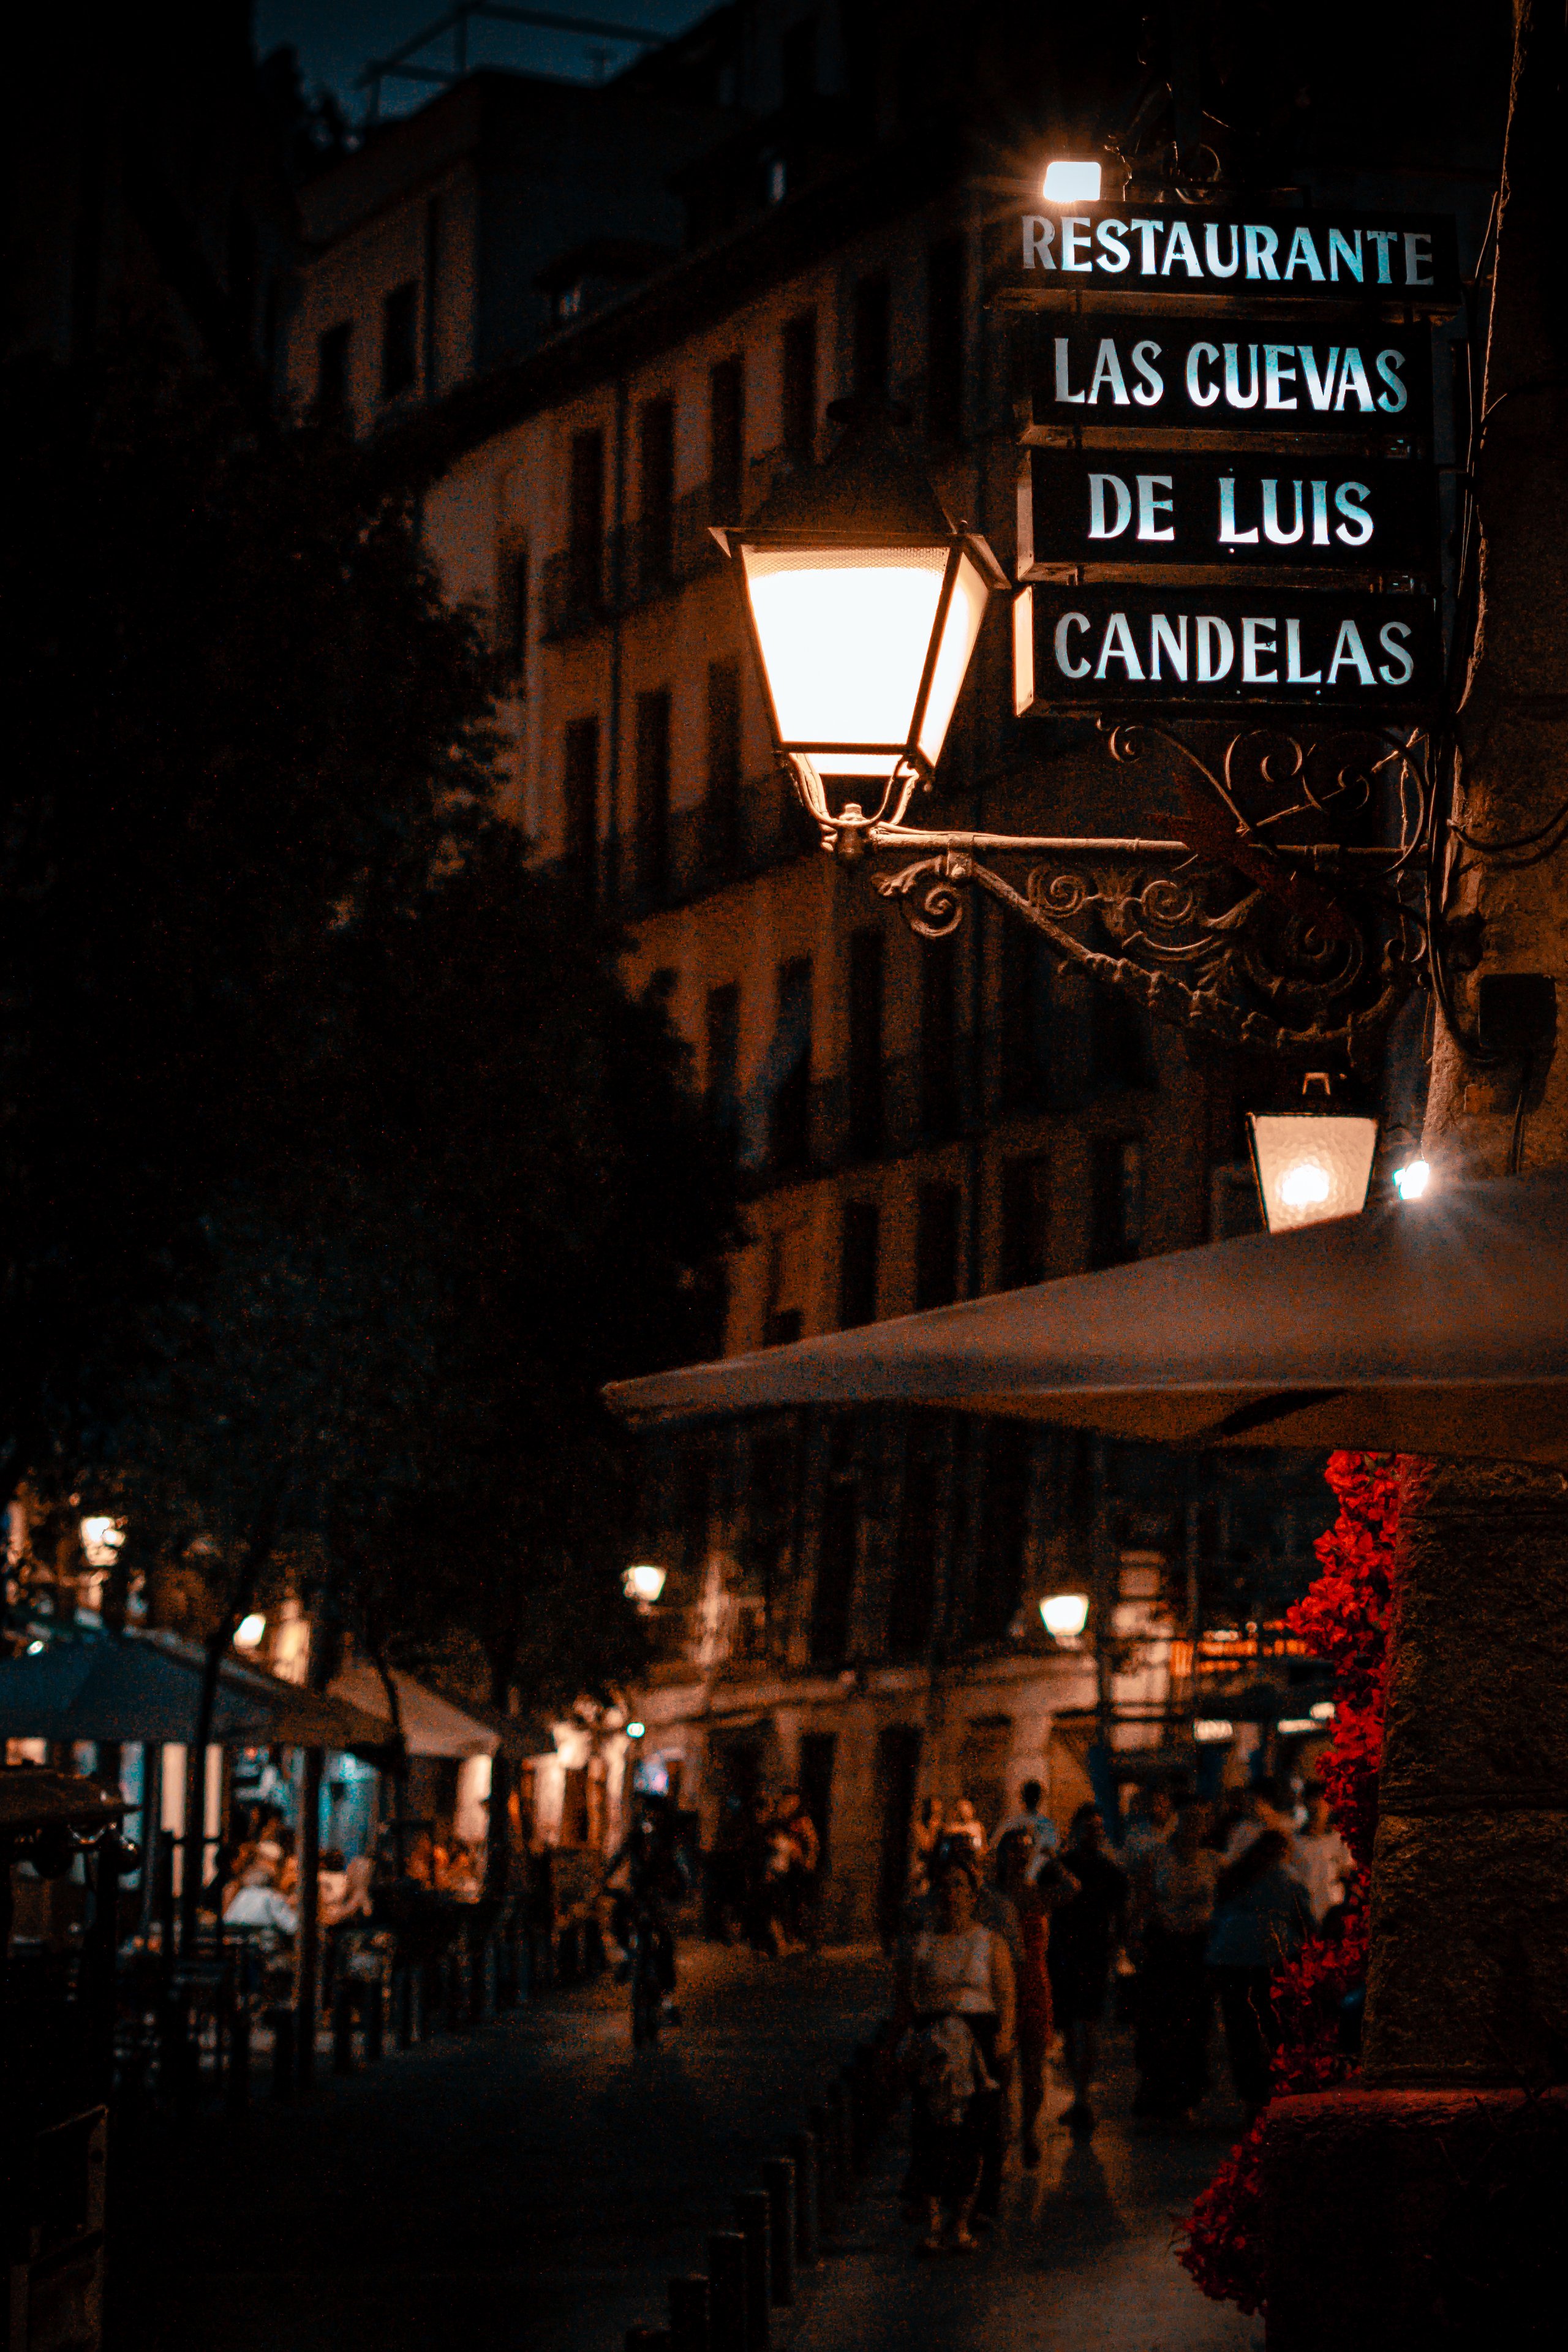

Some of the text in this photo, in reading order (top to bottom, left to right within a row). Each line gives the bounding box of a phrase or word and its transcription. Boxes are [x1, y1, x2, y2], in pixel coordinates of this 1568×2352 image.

[1022, 215, 1434, 286] RESTAURANTE
[1054, 338, 1408, 413] LAS CUEVAS
[1088, 474, 1374, 546] DE LUIS
[1055, 612, 1414, 685] CANDELAS
